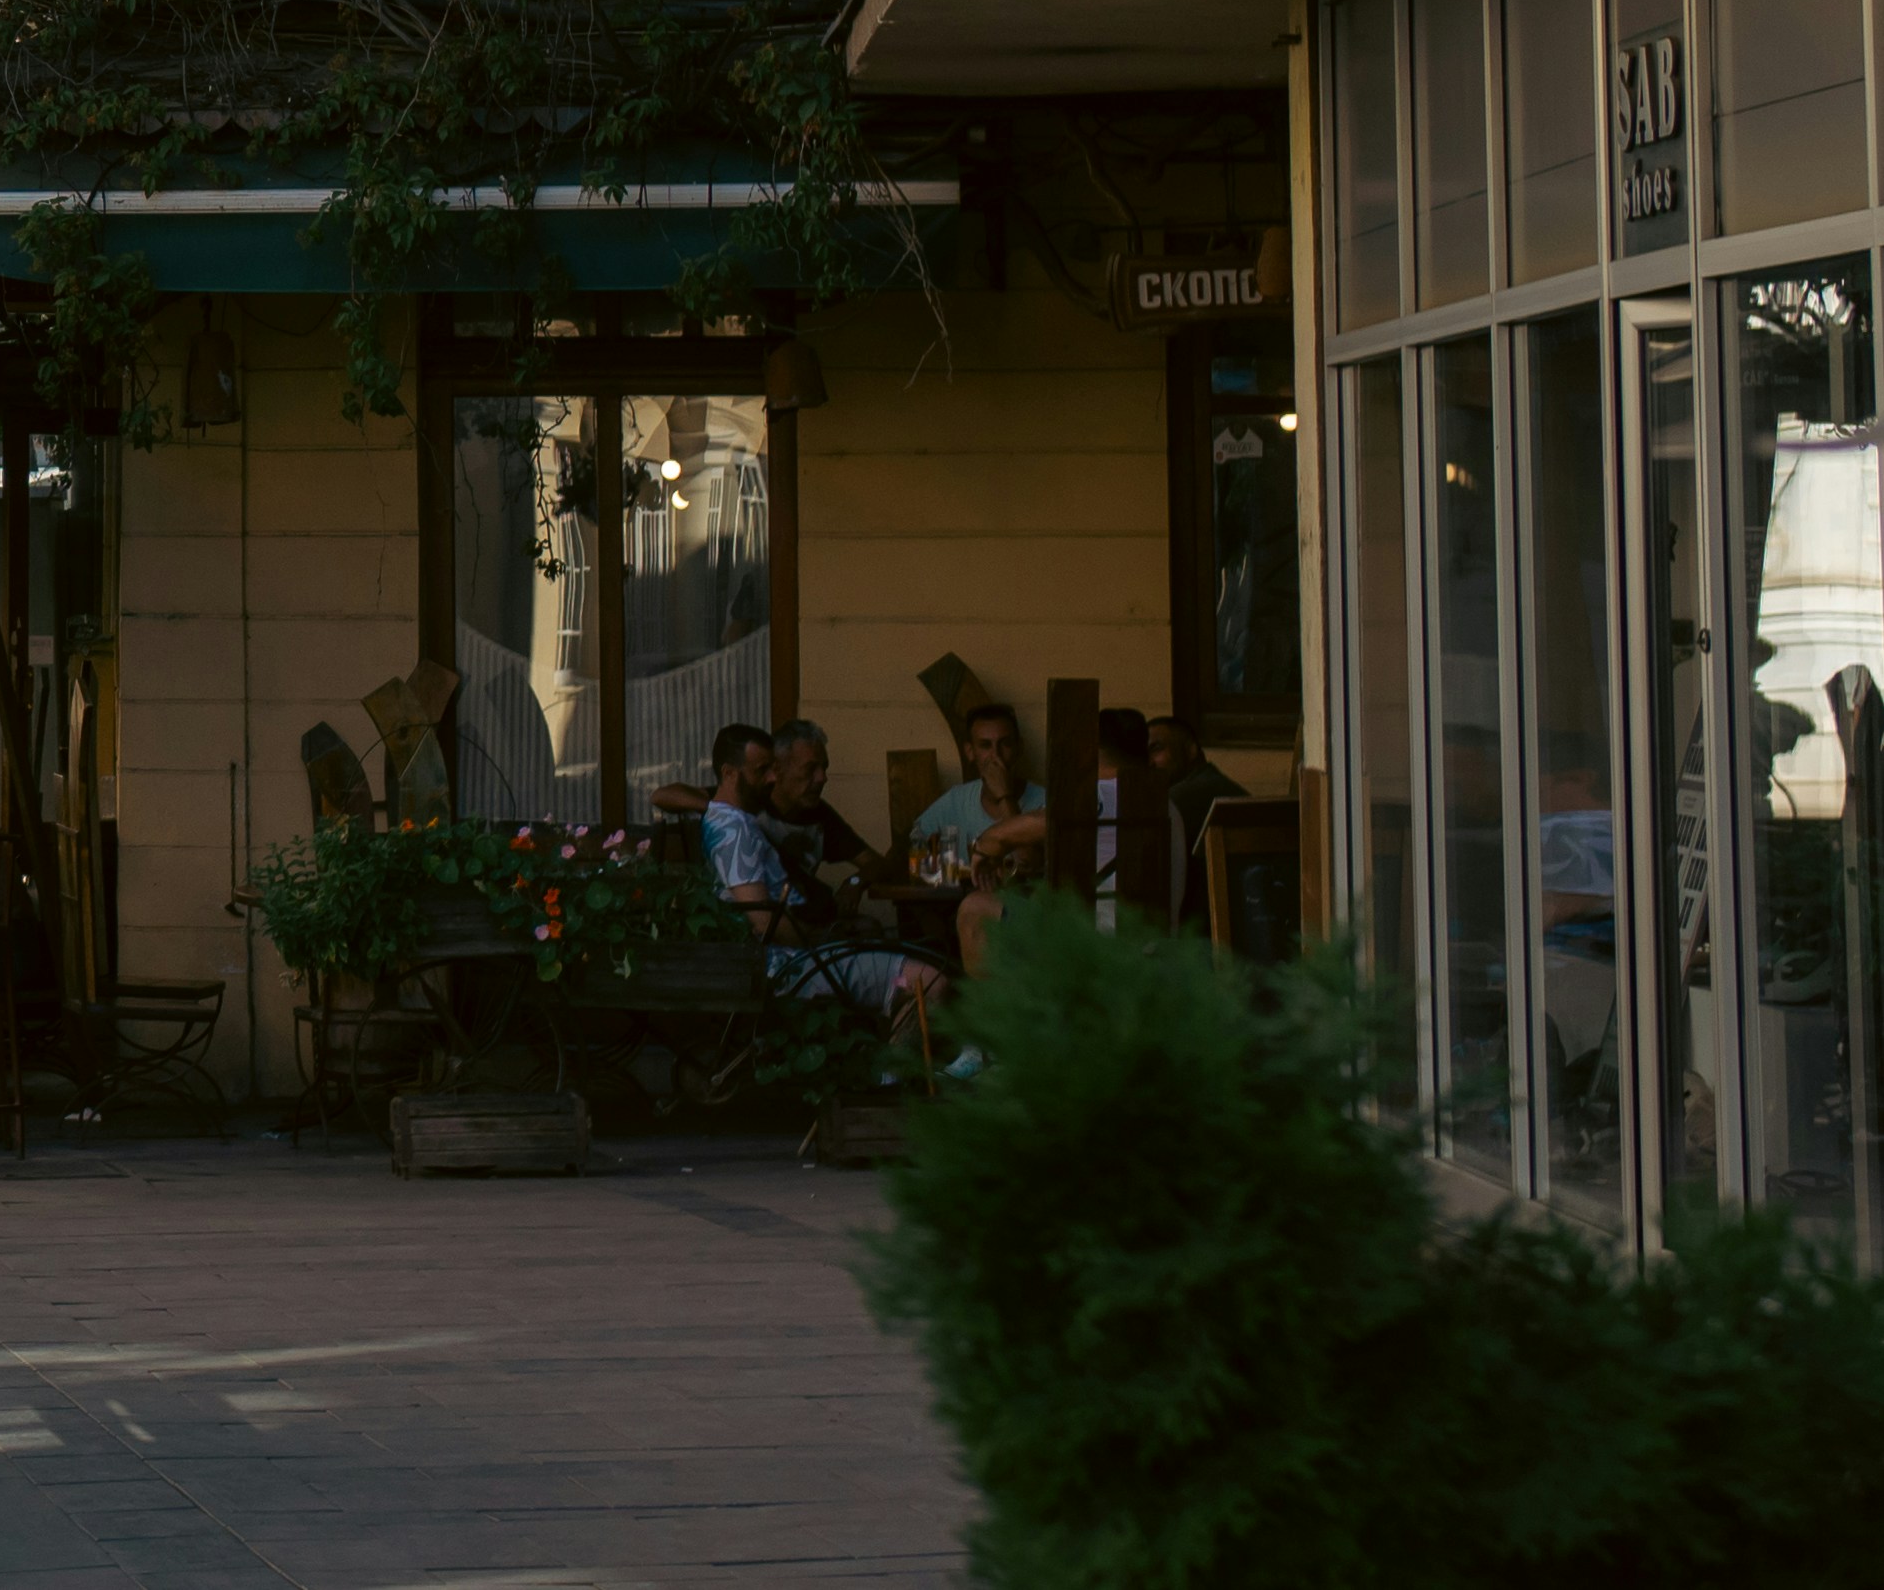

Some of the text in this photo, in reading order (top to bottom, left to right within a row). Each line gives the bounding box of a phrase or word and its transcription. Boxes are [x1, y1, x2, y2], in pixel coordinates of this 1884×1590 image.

[1617, 37, 1677, 152] SAB
[1623, 161, 1673, 221] shoes
[1137, 268, 1264, 309] СКОПС
